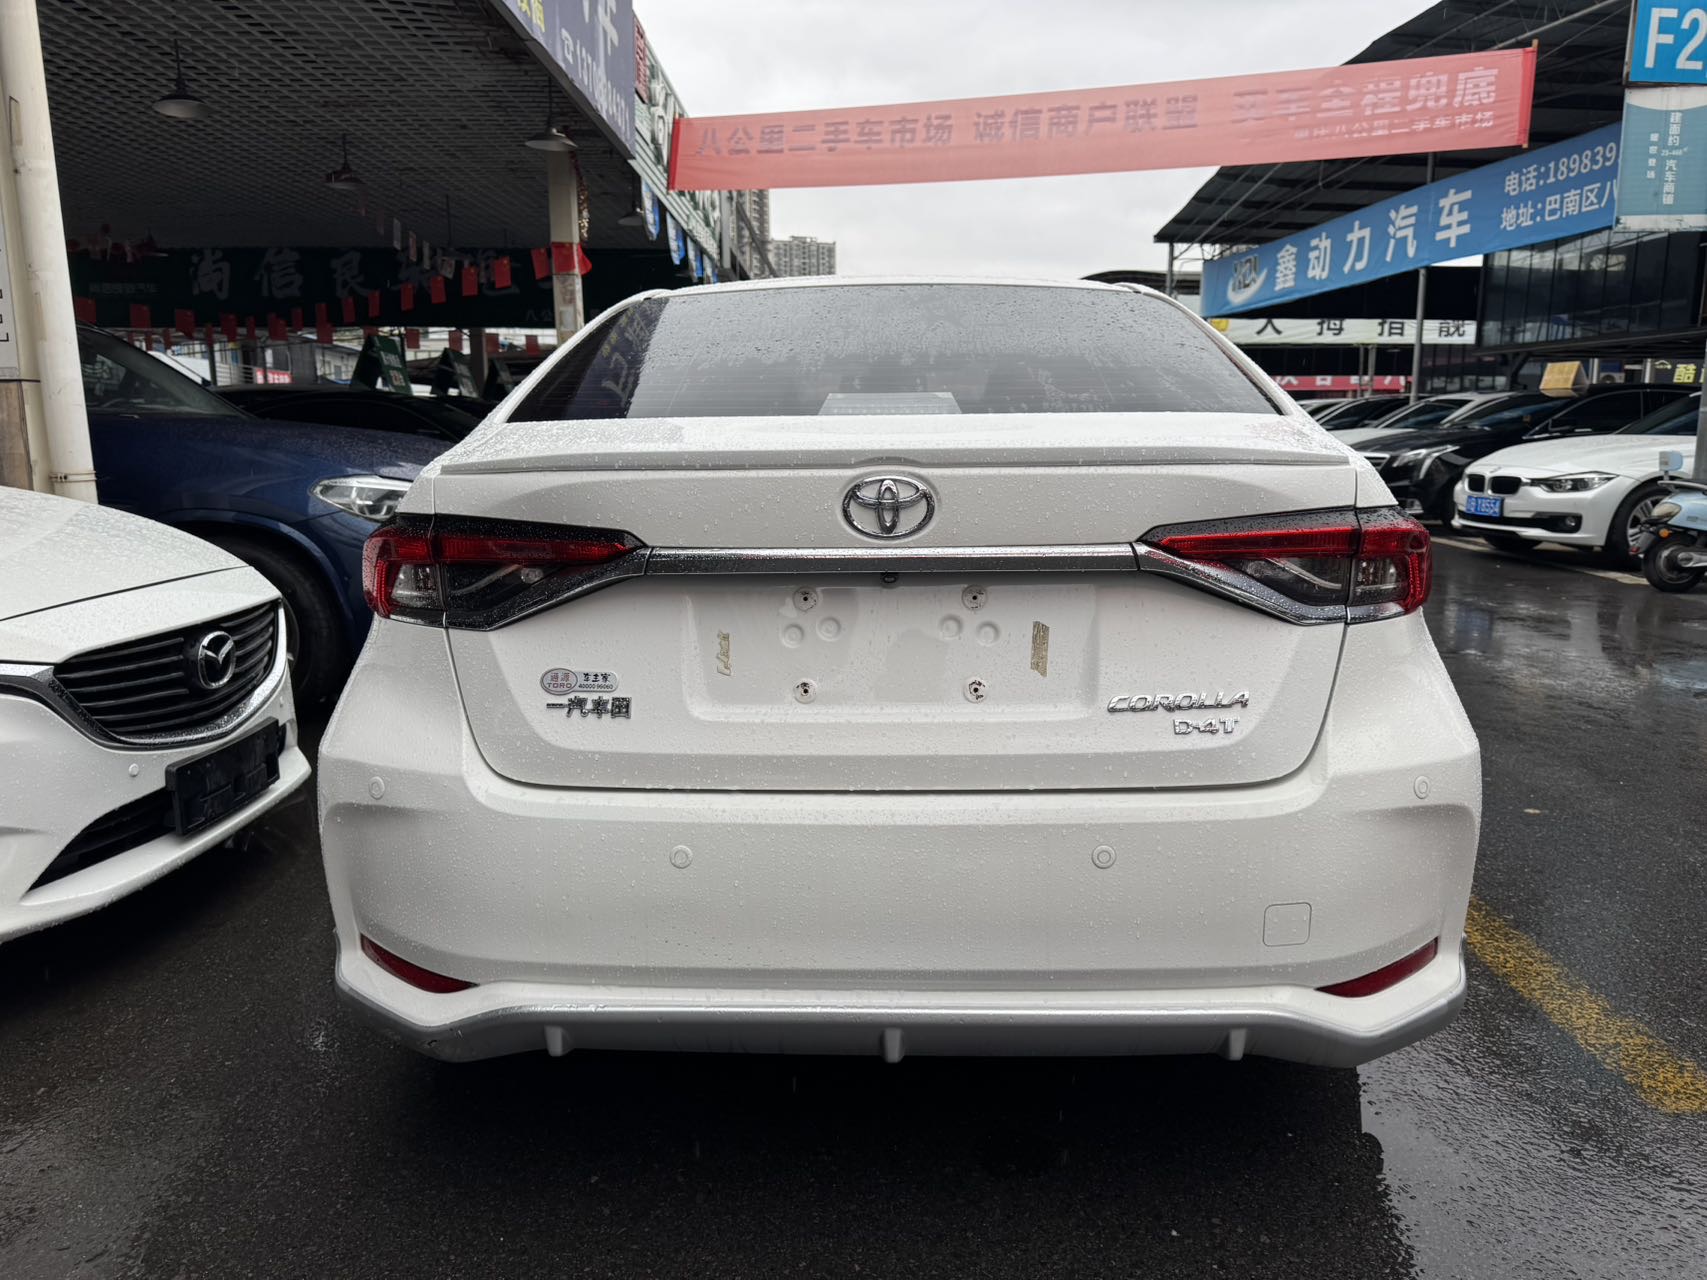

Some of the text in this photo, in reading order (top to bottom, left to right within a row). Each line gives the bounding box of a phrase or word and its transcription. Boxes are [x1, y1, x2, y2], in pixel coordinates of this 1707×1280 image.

[695, 113, 954, 156] 八公里二手车市场
[974, 96, 1199, 142] 诚信商户联盟
[1274, 188, 1472, 292] 鑫动力汽车
[1107, 690, 1250, 713] COROLLA
